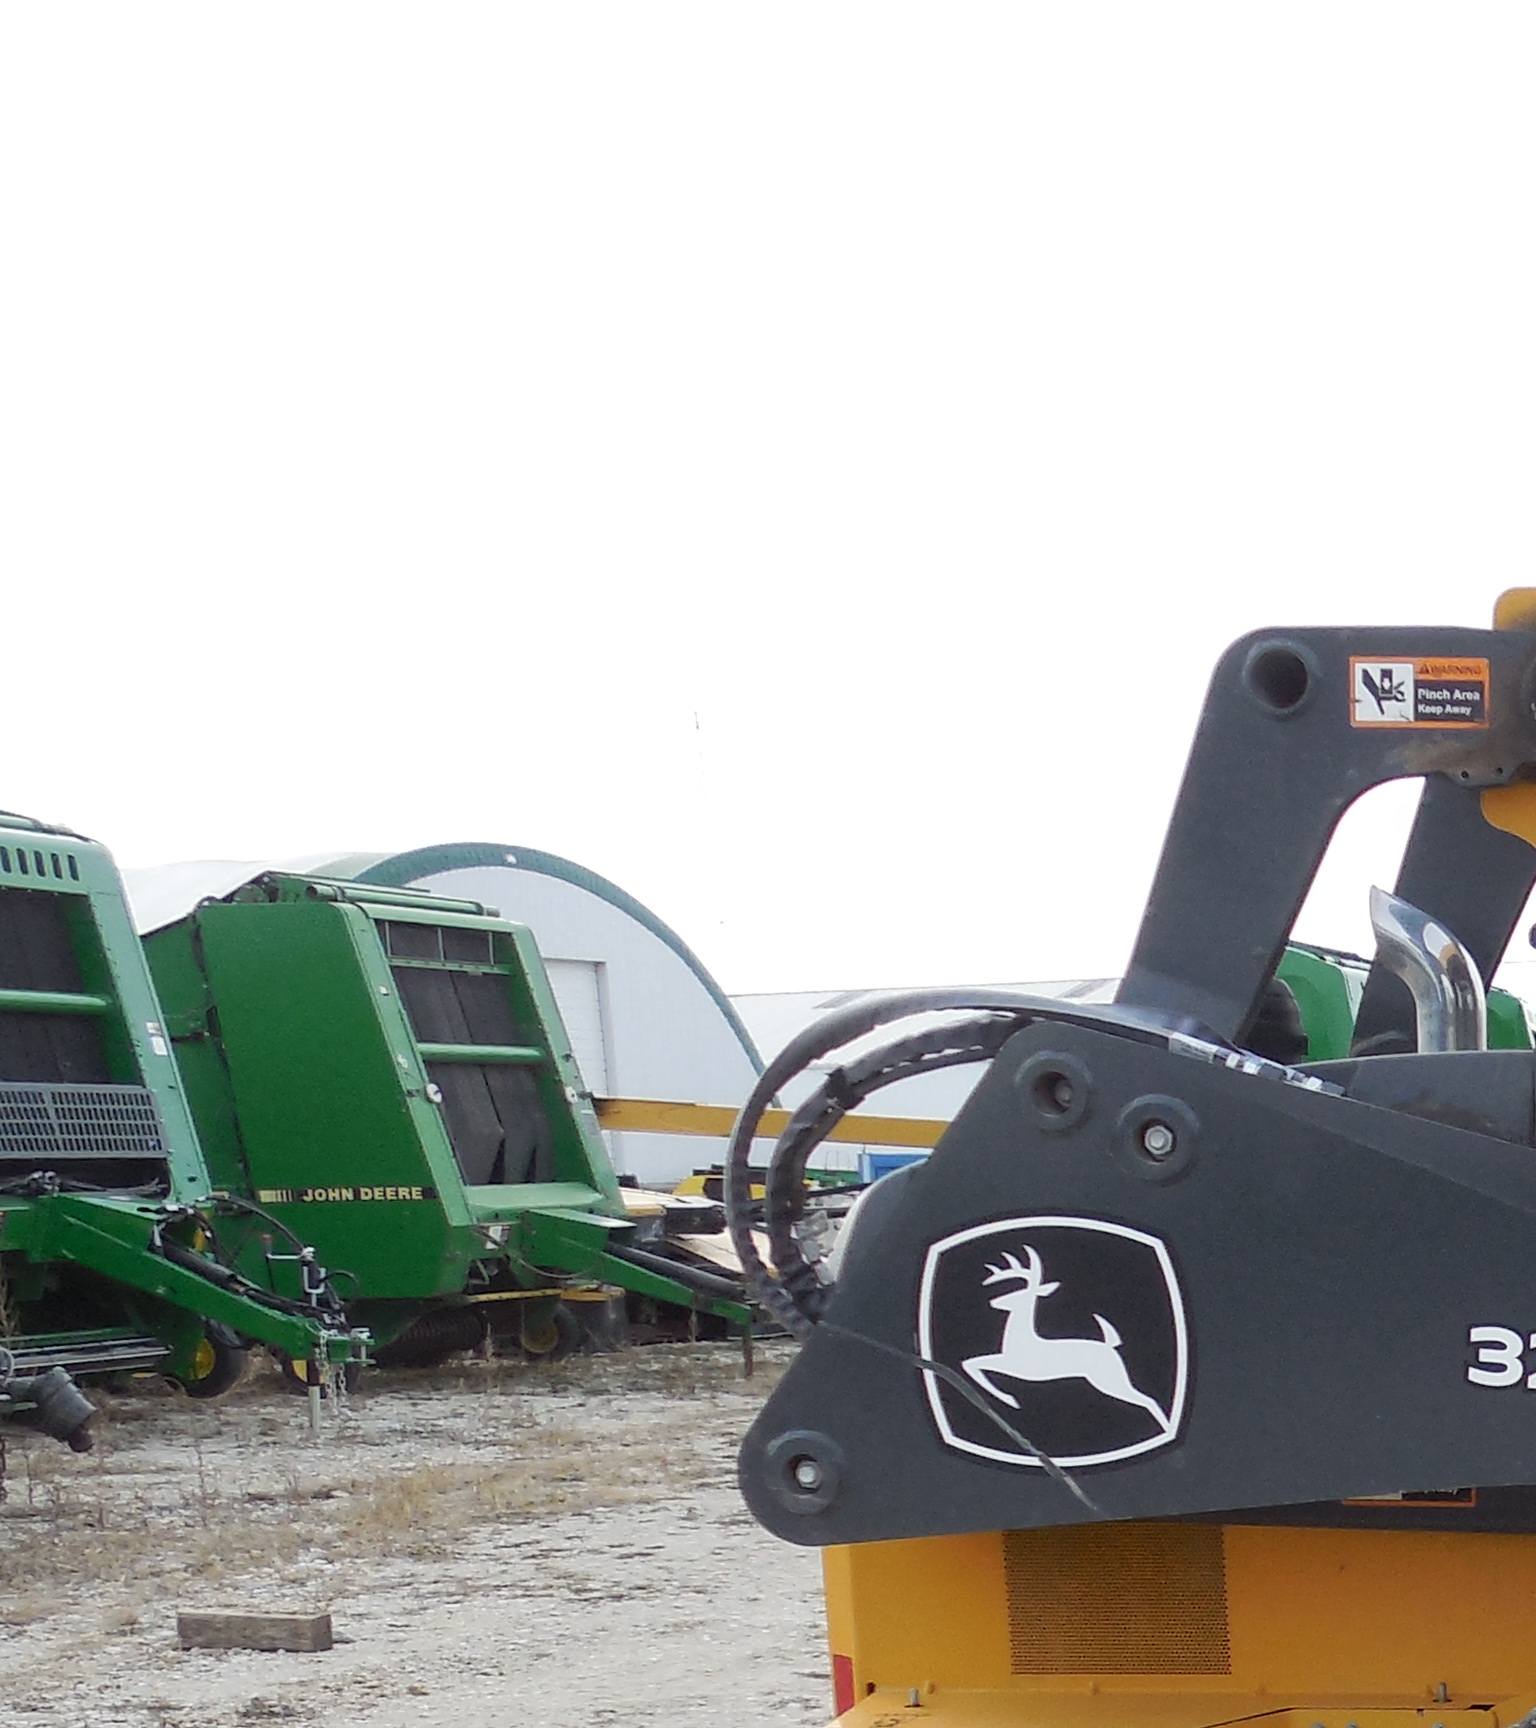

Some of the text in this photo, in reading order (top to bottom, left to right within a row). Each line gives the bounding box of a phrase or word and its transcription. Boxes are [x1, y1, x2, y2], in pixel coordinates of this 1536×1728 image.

[1417, 688, 1480, 701] Pinch Area
[1417, 704, 1472, 716] Keep Away
[303, 1186, 423, 1202] JOHN DEERE
